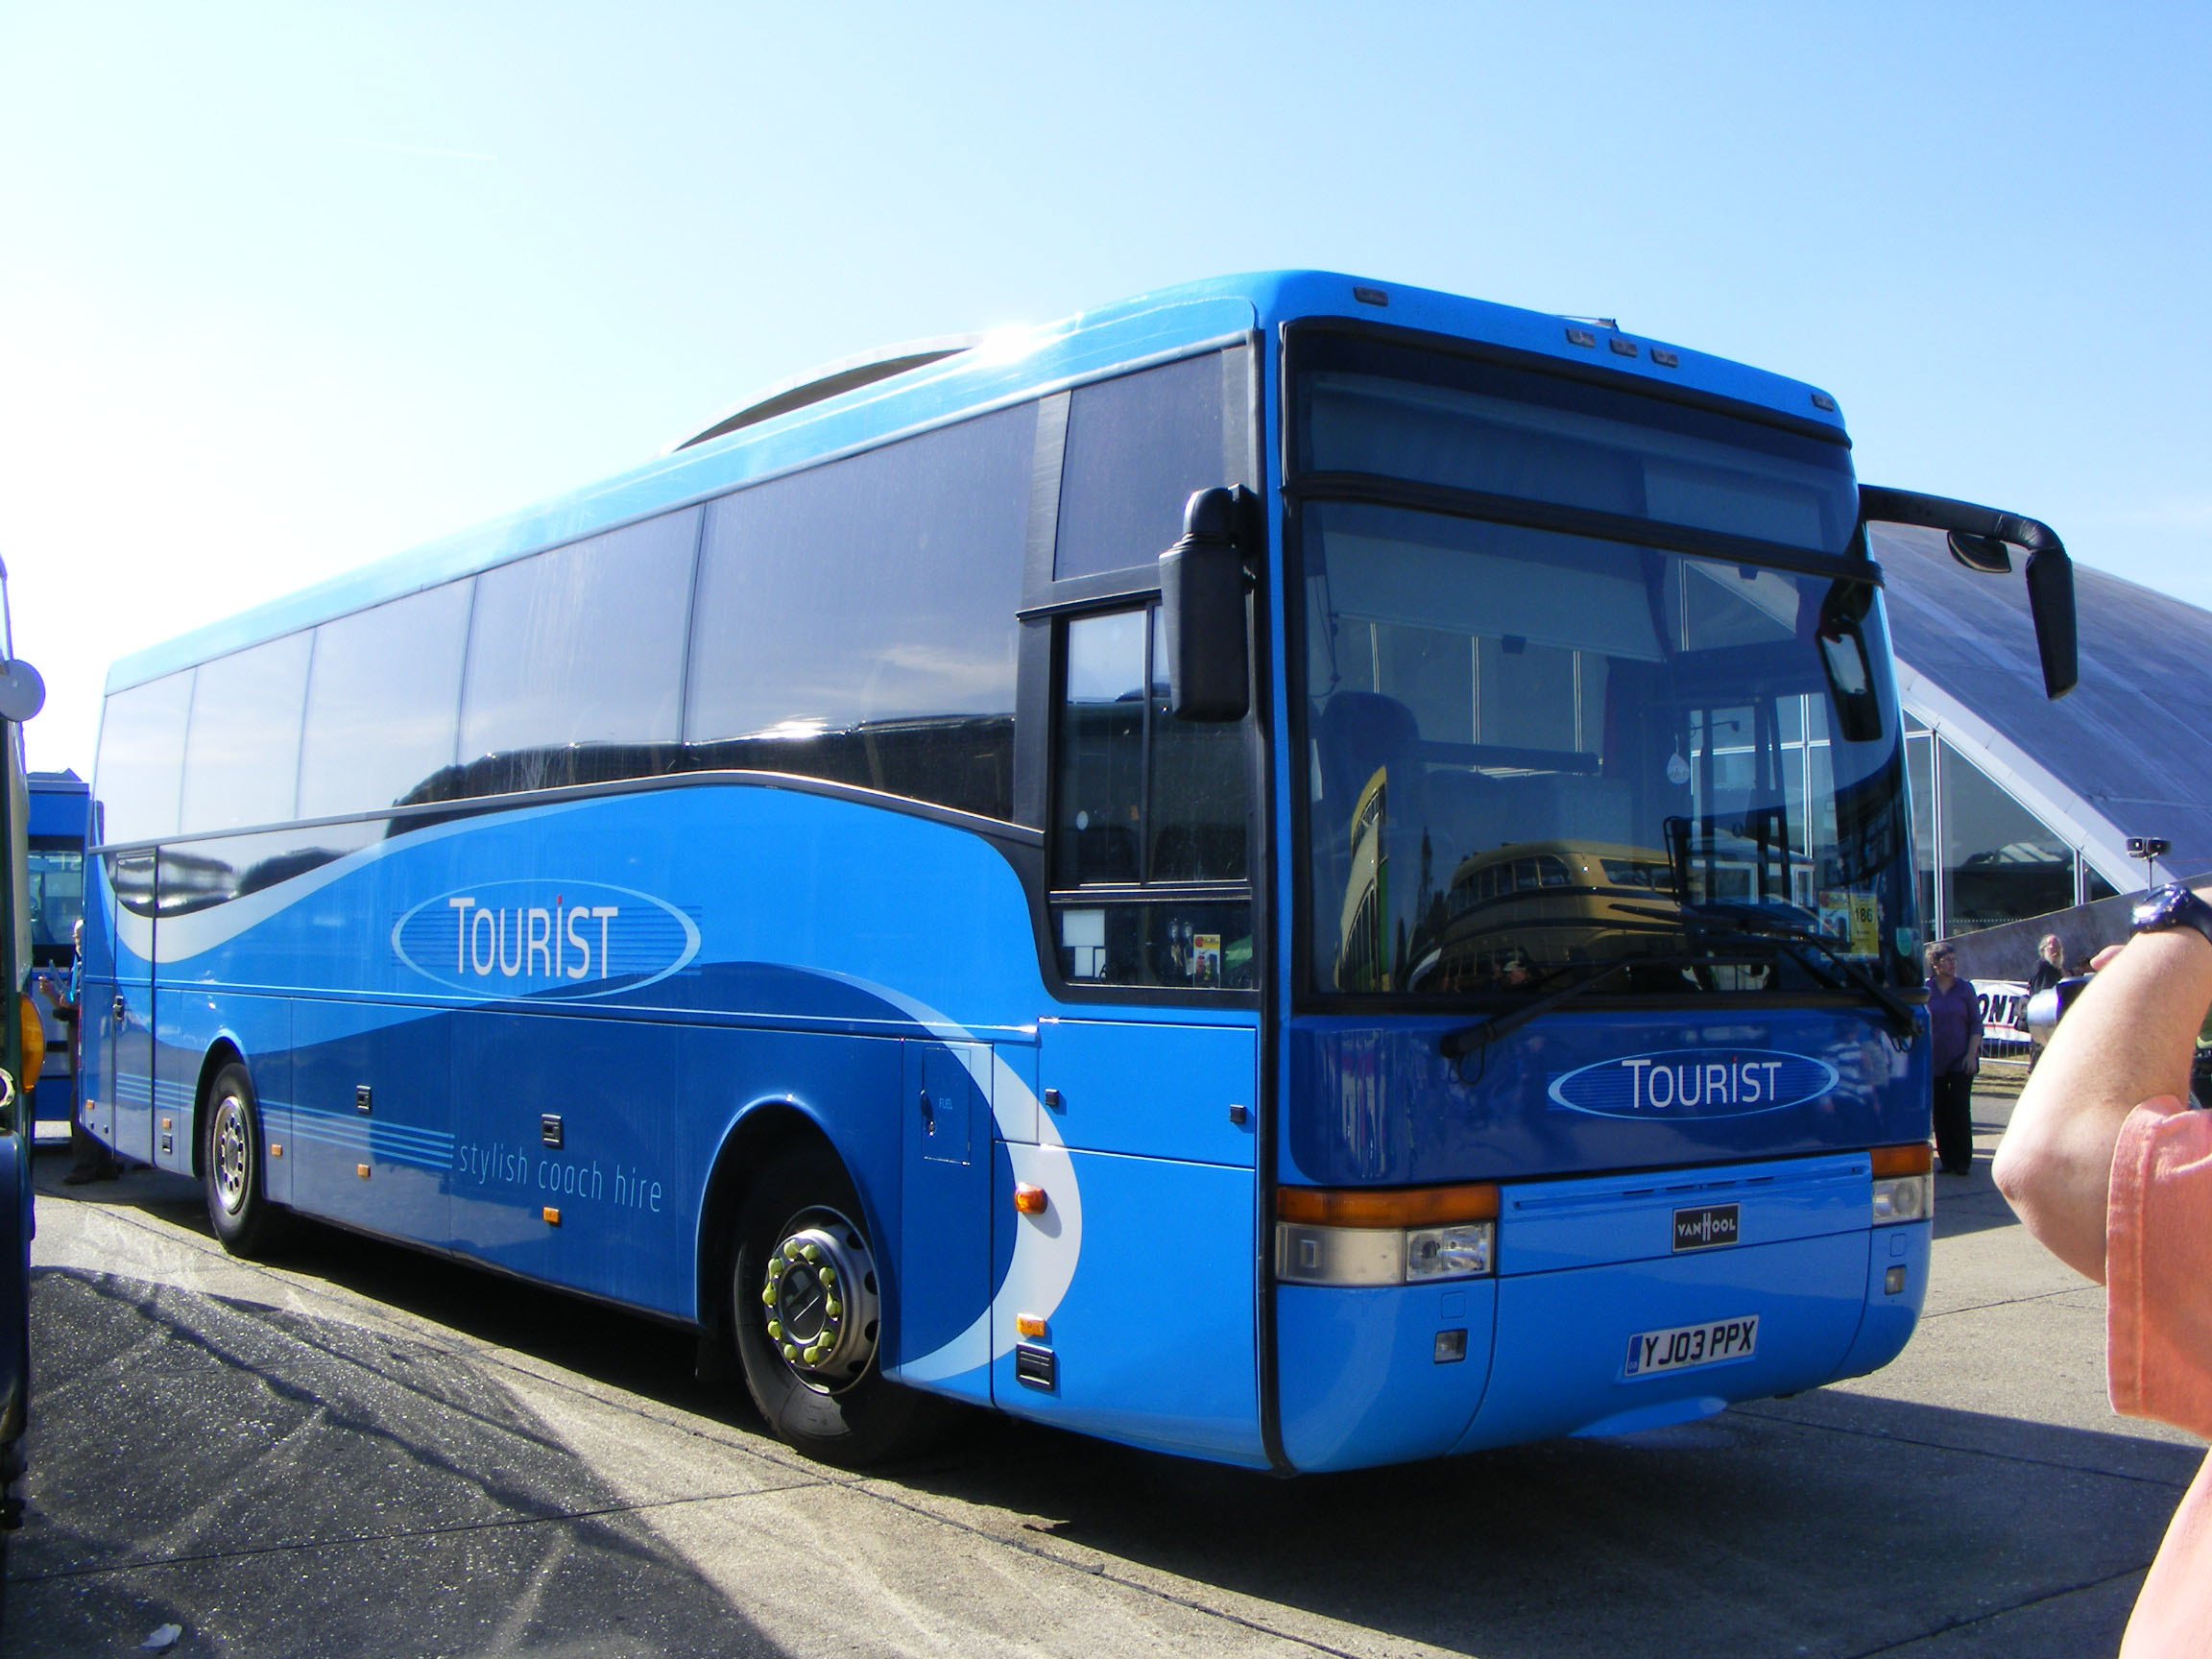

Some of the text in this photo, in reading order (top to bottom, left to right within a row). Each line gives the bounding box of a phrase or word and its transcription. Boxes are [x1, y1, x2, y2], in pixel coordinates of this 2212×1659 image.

[1855, 907, 1873, 923] 186
[460, 1142, 662, 1213] stylish coach hire
[1645, 1320, 1756, 1368] YJ03 PPX
